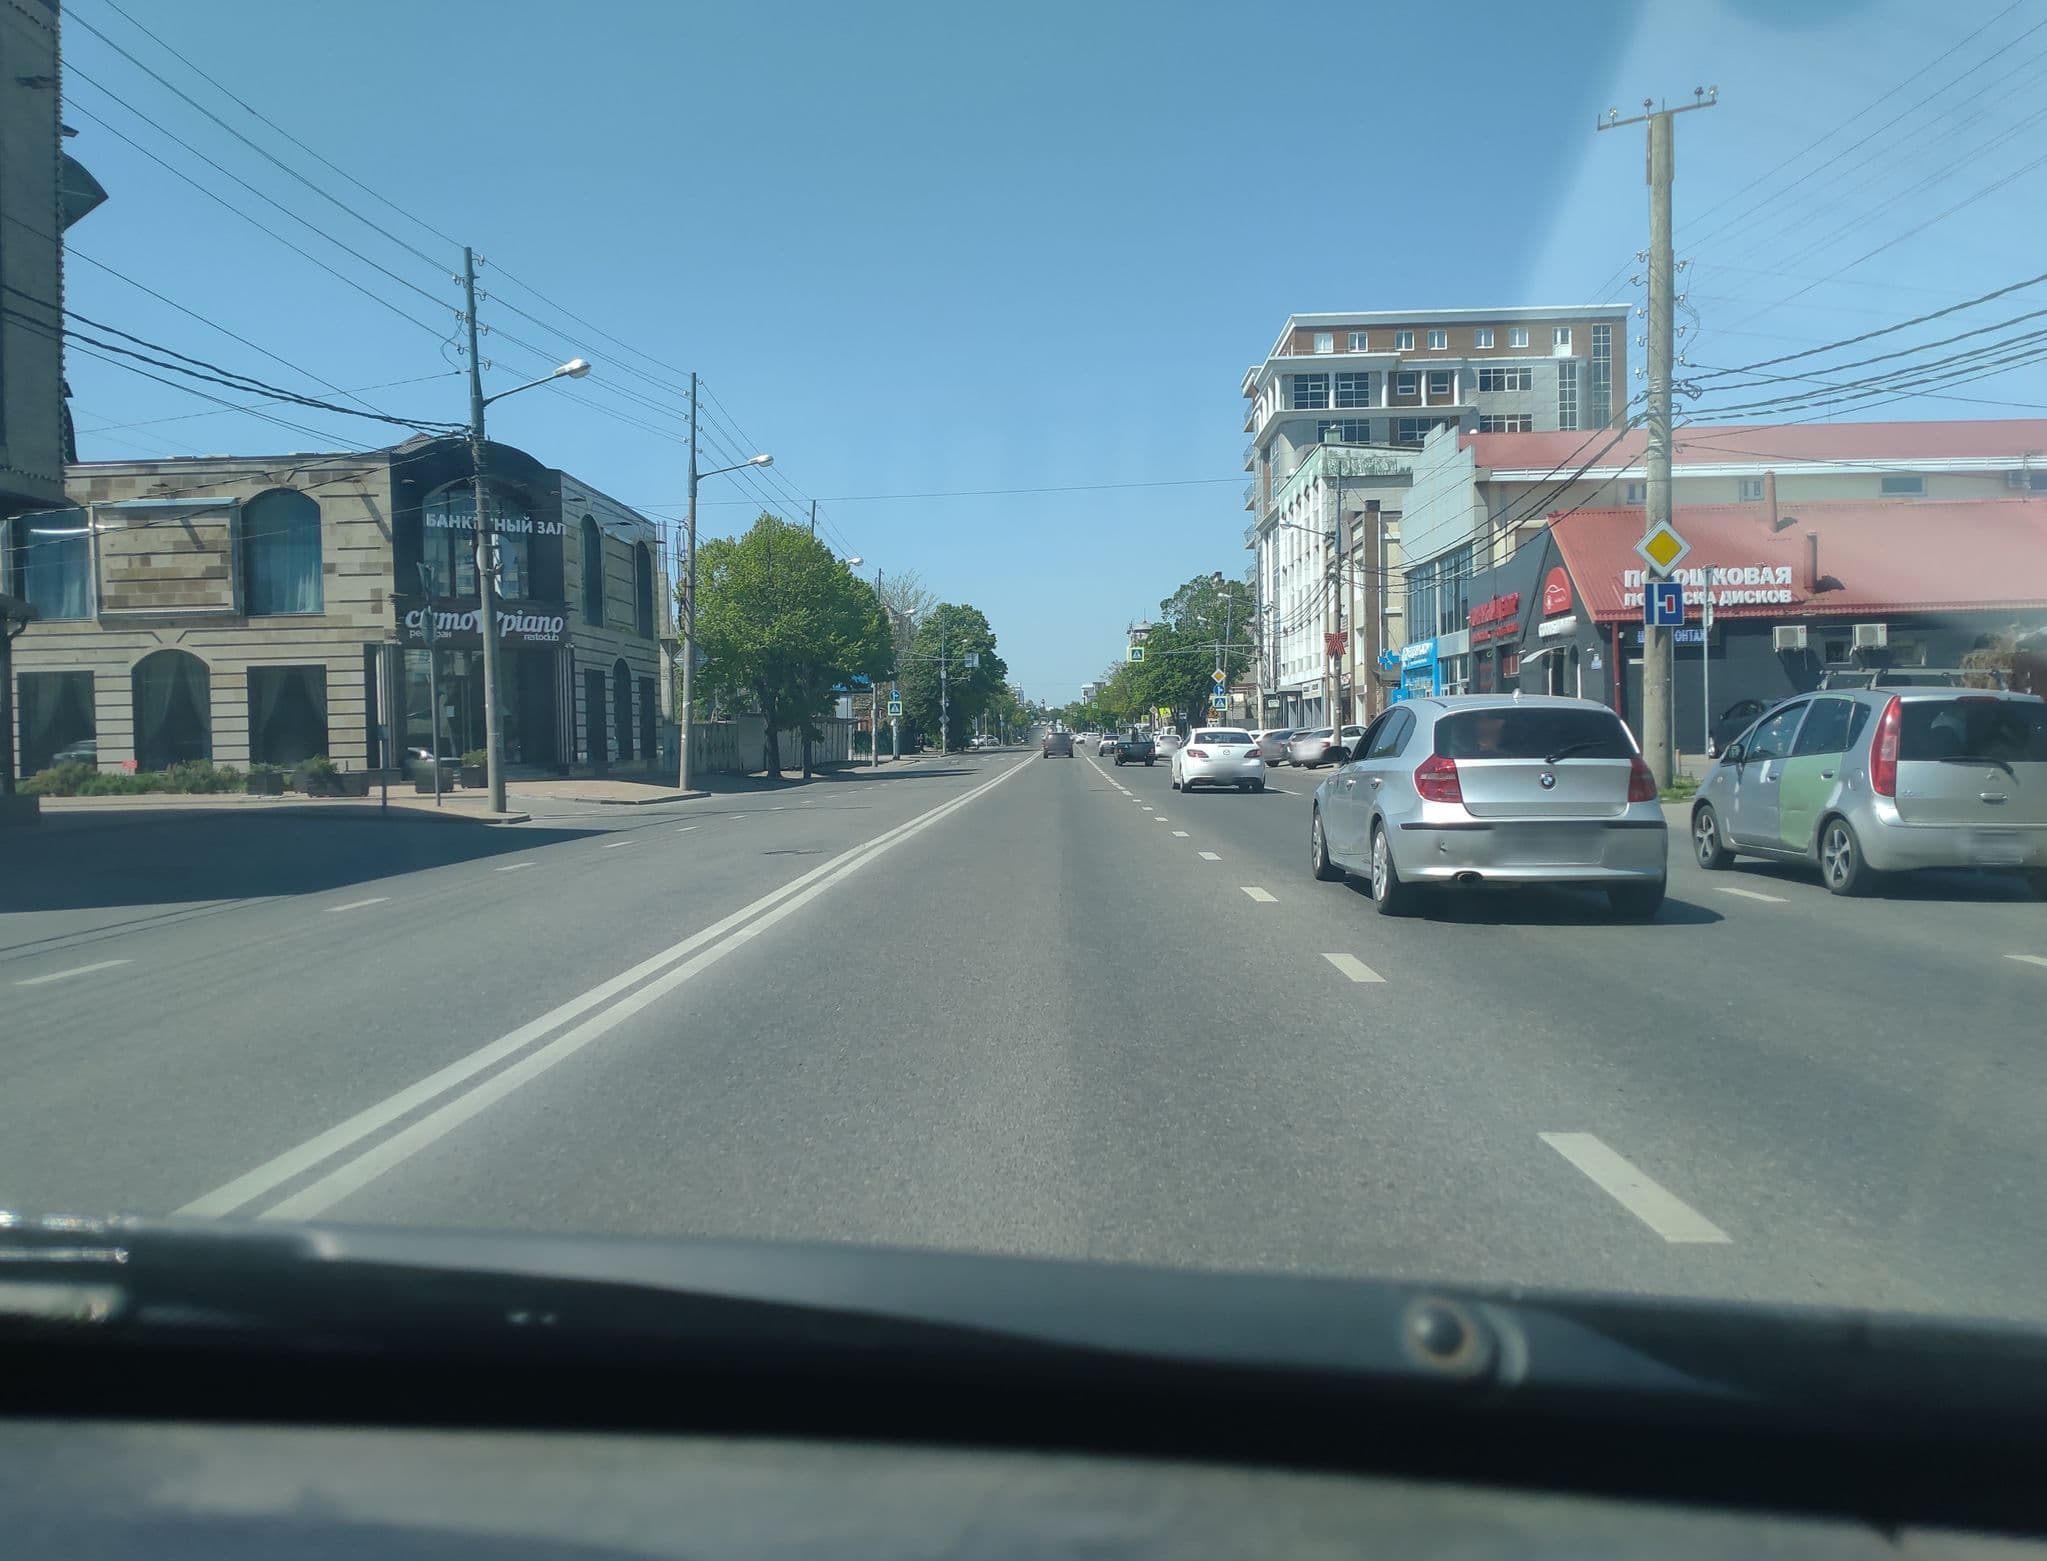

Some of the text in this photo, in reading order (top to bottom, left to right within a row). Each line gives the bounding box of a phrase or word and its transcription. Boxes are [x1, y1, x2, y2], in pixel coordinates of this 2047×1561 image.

[426, 513, 567, 536] БАНКНЫЙ ЗАЛ
[1719, 589, 1793, 607] ДИСКОВ
[500, 609, 564, 637] piano
